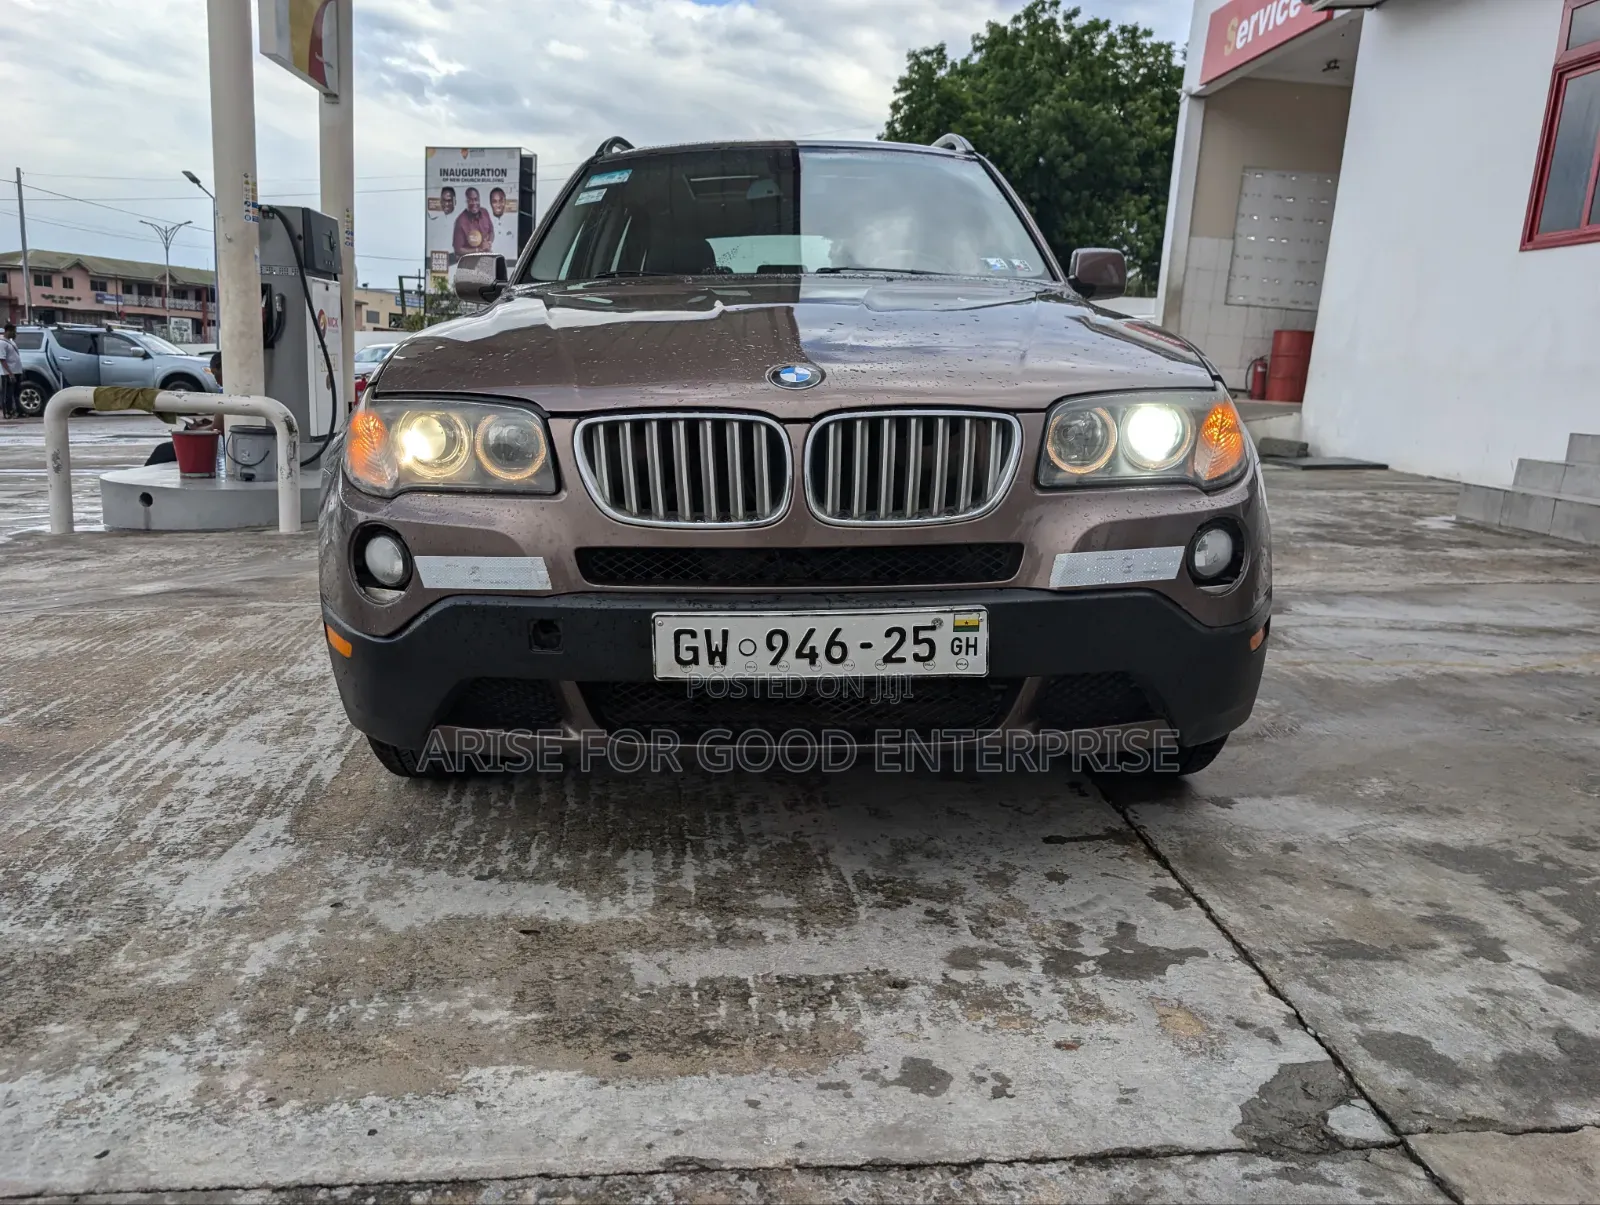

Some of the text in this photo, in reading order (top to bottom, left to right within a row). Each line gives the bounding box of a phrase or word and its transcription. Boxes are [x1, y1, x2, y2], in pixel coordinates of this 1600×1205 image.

[1224, 0, 1301, 56] Service
[439, 168, 507, 178] INAUGURATION
[673, 627, 730, 667] GW
[950, 636, 978, 656] GH
